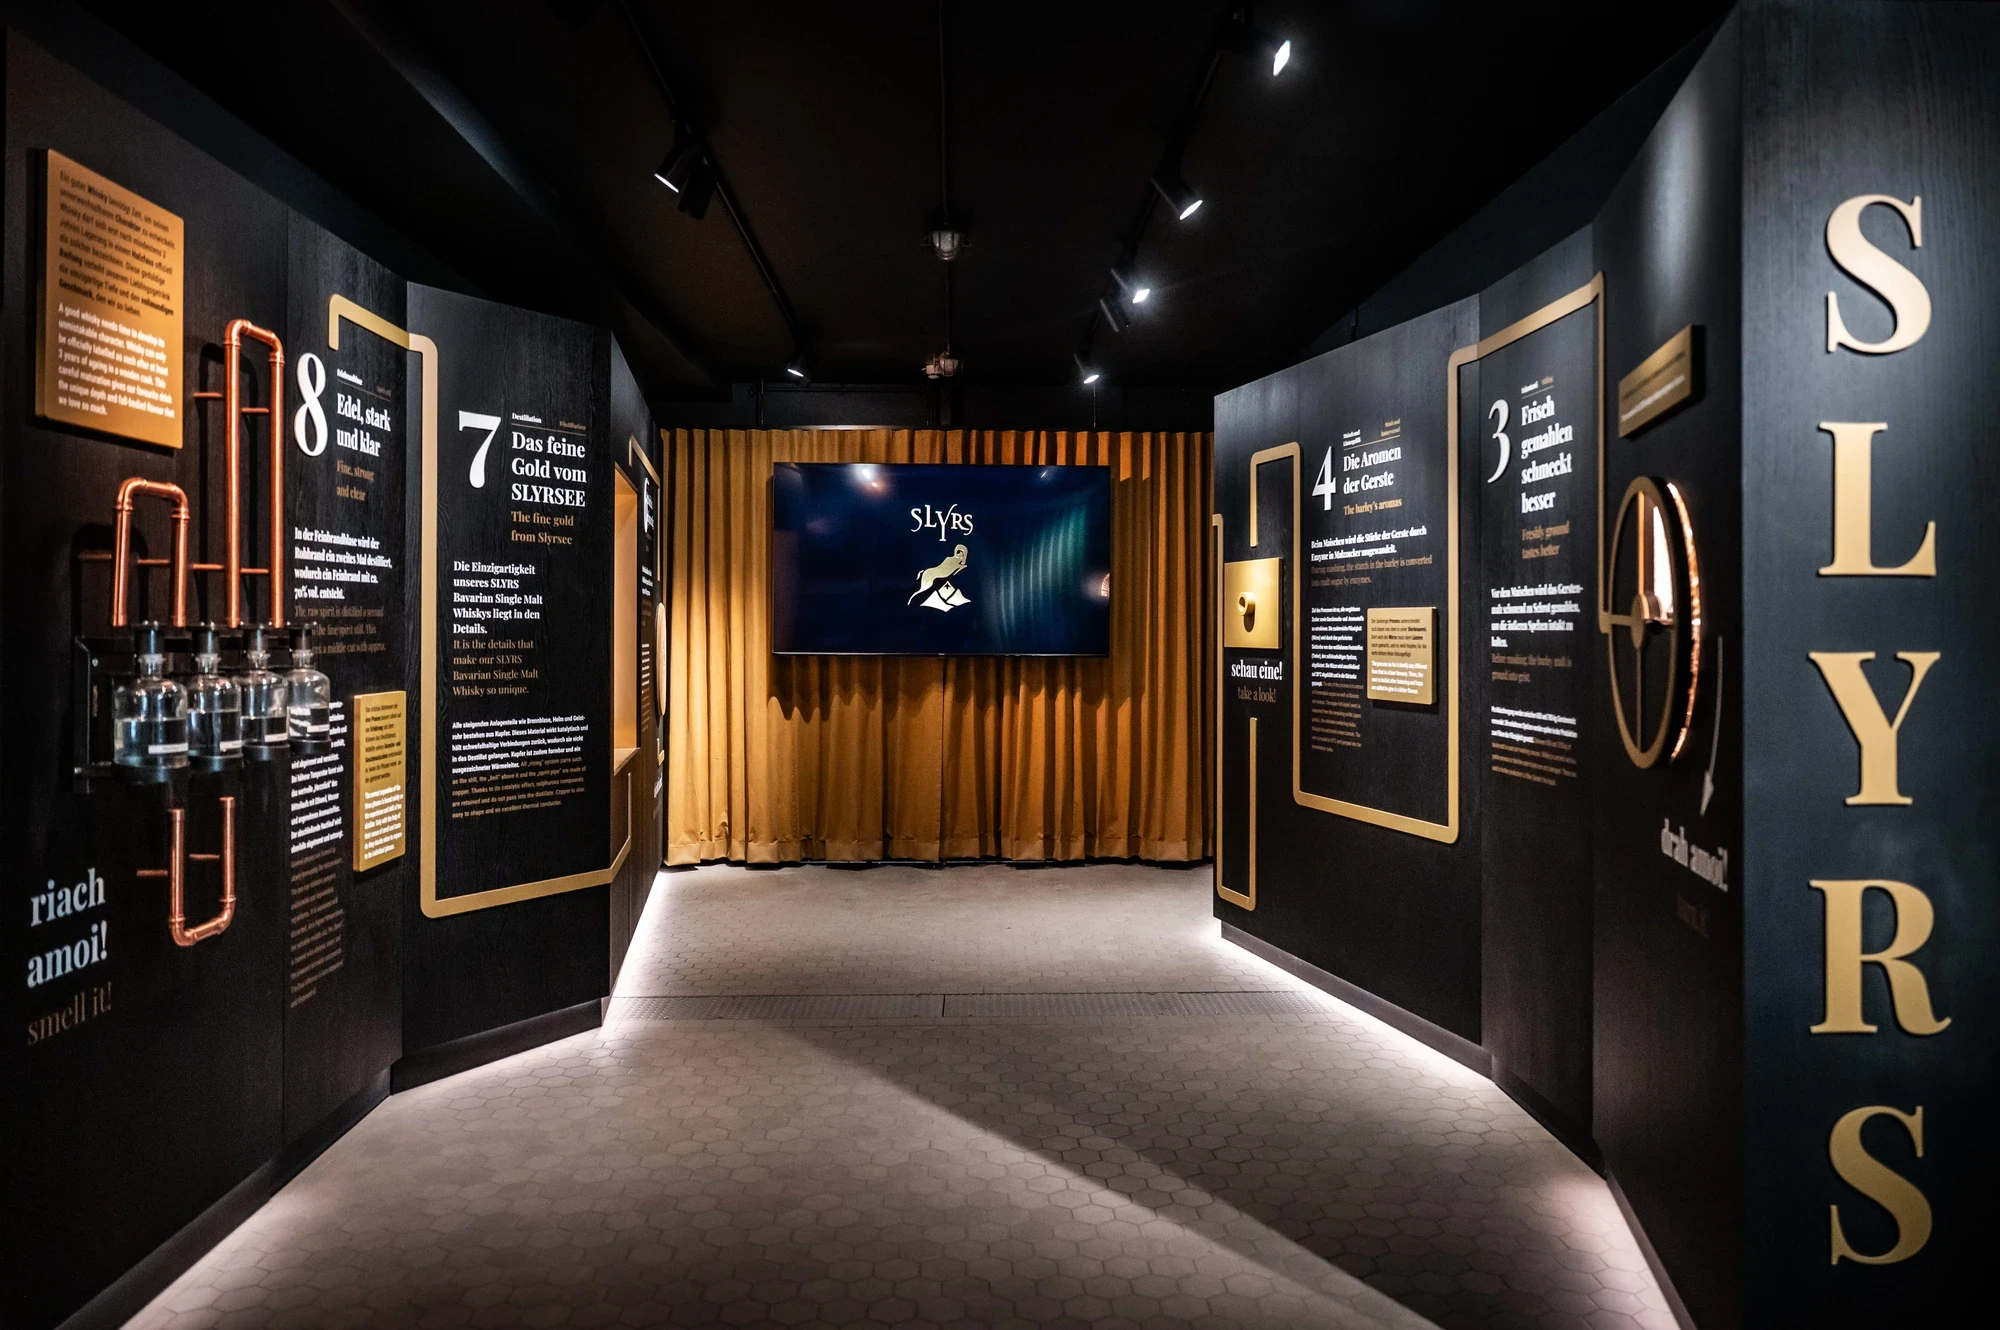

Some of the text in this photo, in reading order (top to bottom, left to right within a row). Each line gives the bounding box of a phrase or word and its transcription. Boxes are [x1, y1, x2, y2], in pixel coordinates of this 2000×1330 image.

[294, 353, 328, 456] 8
[337, 393, 391, 431] Edel, stark
[1522, 395, 1555, 425] Frisch
[512, 413, 541, 423] Destillation
[337, 428, 380, 456] und klar
[459, 411, 501, 488] 7
[512, 432, 585, 458] Das feine
[1488, 399, 1510, 483] 3
[1521, 423, 1573, 459] gemahlen
[1344, 447, 1401, 471] Die Aromen
[1522, 453, 1572, 484] schmeckt
[337, 460, 374, 482] Fine, strong
[512, 458, 586, 482] Gold vom
[1312, 446, 1336, 510] 4
[1344, 471, 1394, 494] der Gerste
[337, 485, 366, 501] and clear
[512, 483, 585, 507] SLYRSEE
[1521, 492, 1556, 513] besser
[1344, 499, 1402, 515] The barley's aromas
[511, 511, 573, 526] The fine gold
[911, 504, 973, 541] SLYRS
[295, 527, 302, 539] In
[303, 528, 314, 541] der
[357, 536, 371, 548] wird
[370, 537, 380, 549] der
[512, 530, 572, 545] from Slyrsee
[1382, 531, 1392, 540] der
[1391, 529, 1410, 539] Gerste
[1409, 525, 1427, 536] durch
[326, 550, 335, 562] ein
[295, 566, 323, 579] wodurch
[322, 568, 332, 580] ein
[454, 561, 535, 575] Die Einzigartigkeit
[320, 587, 345, 599] entsteht.
[454, 579, 519, 589] unseres SLYRS
[454, 593, 542, 605] Bavarian Single Malt
[453, 608, 539, 620] Whiskys liegt in den
[453, 623, 487, 633] Details.
[454, 639, 533, 649] It is the details that
[454, 655, 476, 664] make
[496, 655, 522, 663] SLYRS
[454, 669, 538, 680] Bavarian Single Malt
[1232, 660, 1282, 680] schau eine!
[453, 686, 485, 697] Whisky
[499, 685, 529, 695] unique.
[1238, 686, 1276, 702] take a look!
[463, 721, 489, 729] steigenden
[490, 719, 518, 727] Anlagenteile
[1809, 193, 1951, 1267] SLYRS
[488, 753, 510, 761] gelangen.
[31, 868, 105, 927] riach
[28, 920, 107, 988] amoi!
[29, 982, 111, 1046] smell it!
